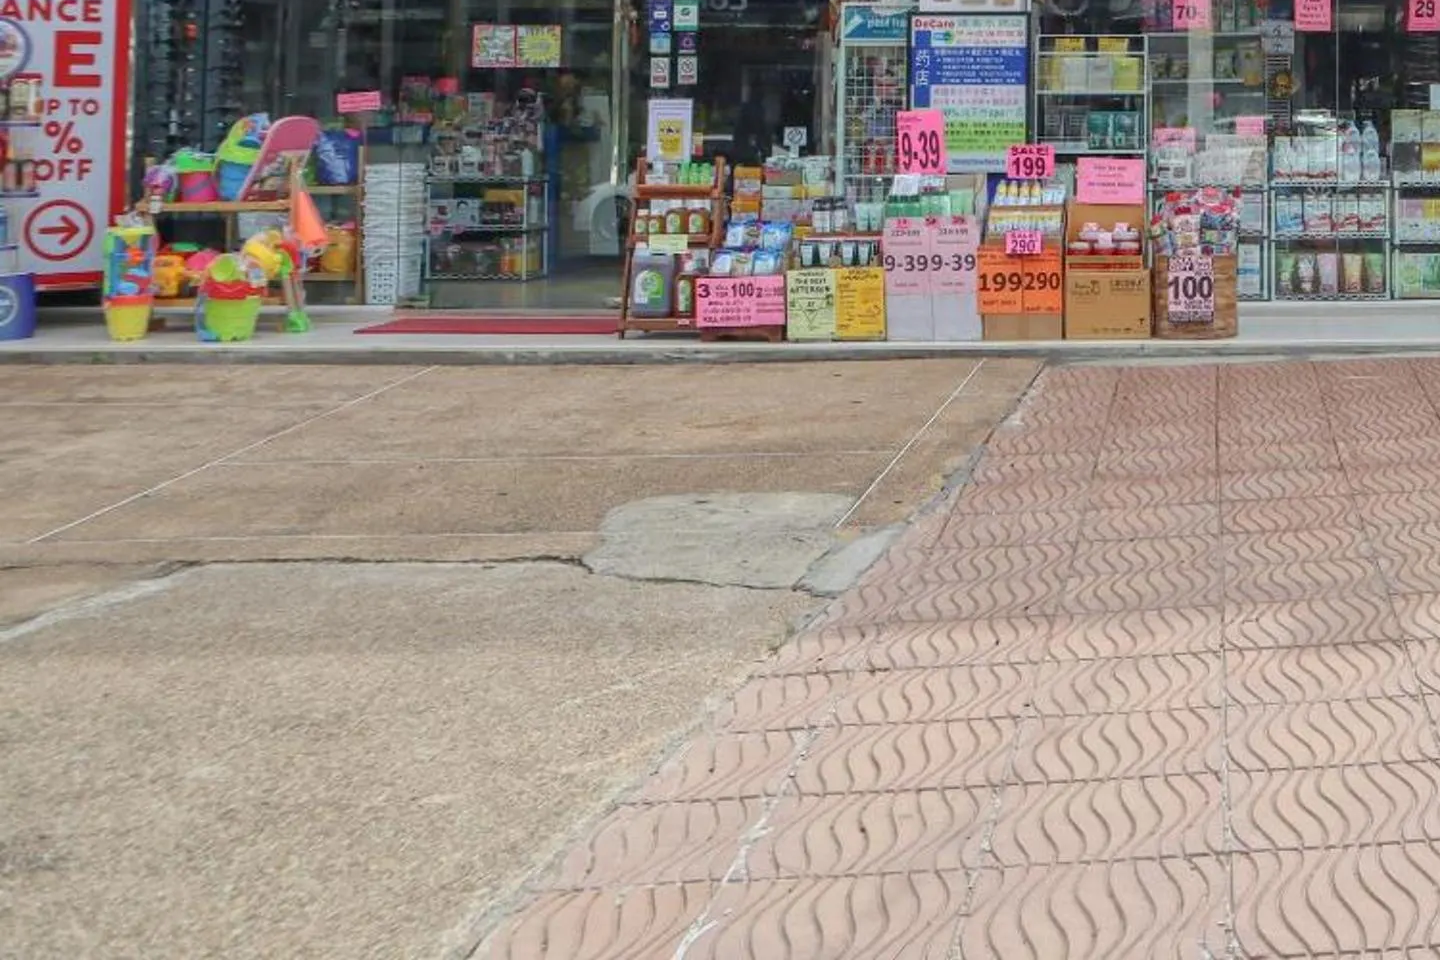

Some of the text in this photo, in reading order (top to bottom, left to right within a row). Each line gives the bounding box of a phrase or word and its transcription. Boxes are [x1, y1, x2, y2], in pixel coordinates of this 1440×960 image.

[1415, 0, 1436, 18] 29
[1012, 157, 1046, 176] 199
[1011, 240, 1036, 253] 290
[731, 283, 753, 297] 100
[979, 272, 1021, 292] 199
[1023, 272, 1060, 290] 290
[1168, 276, 1213, 299] 100
